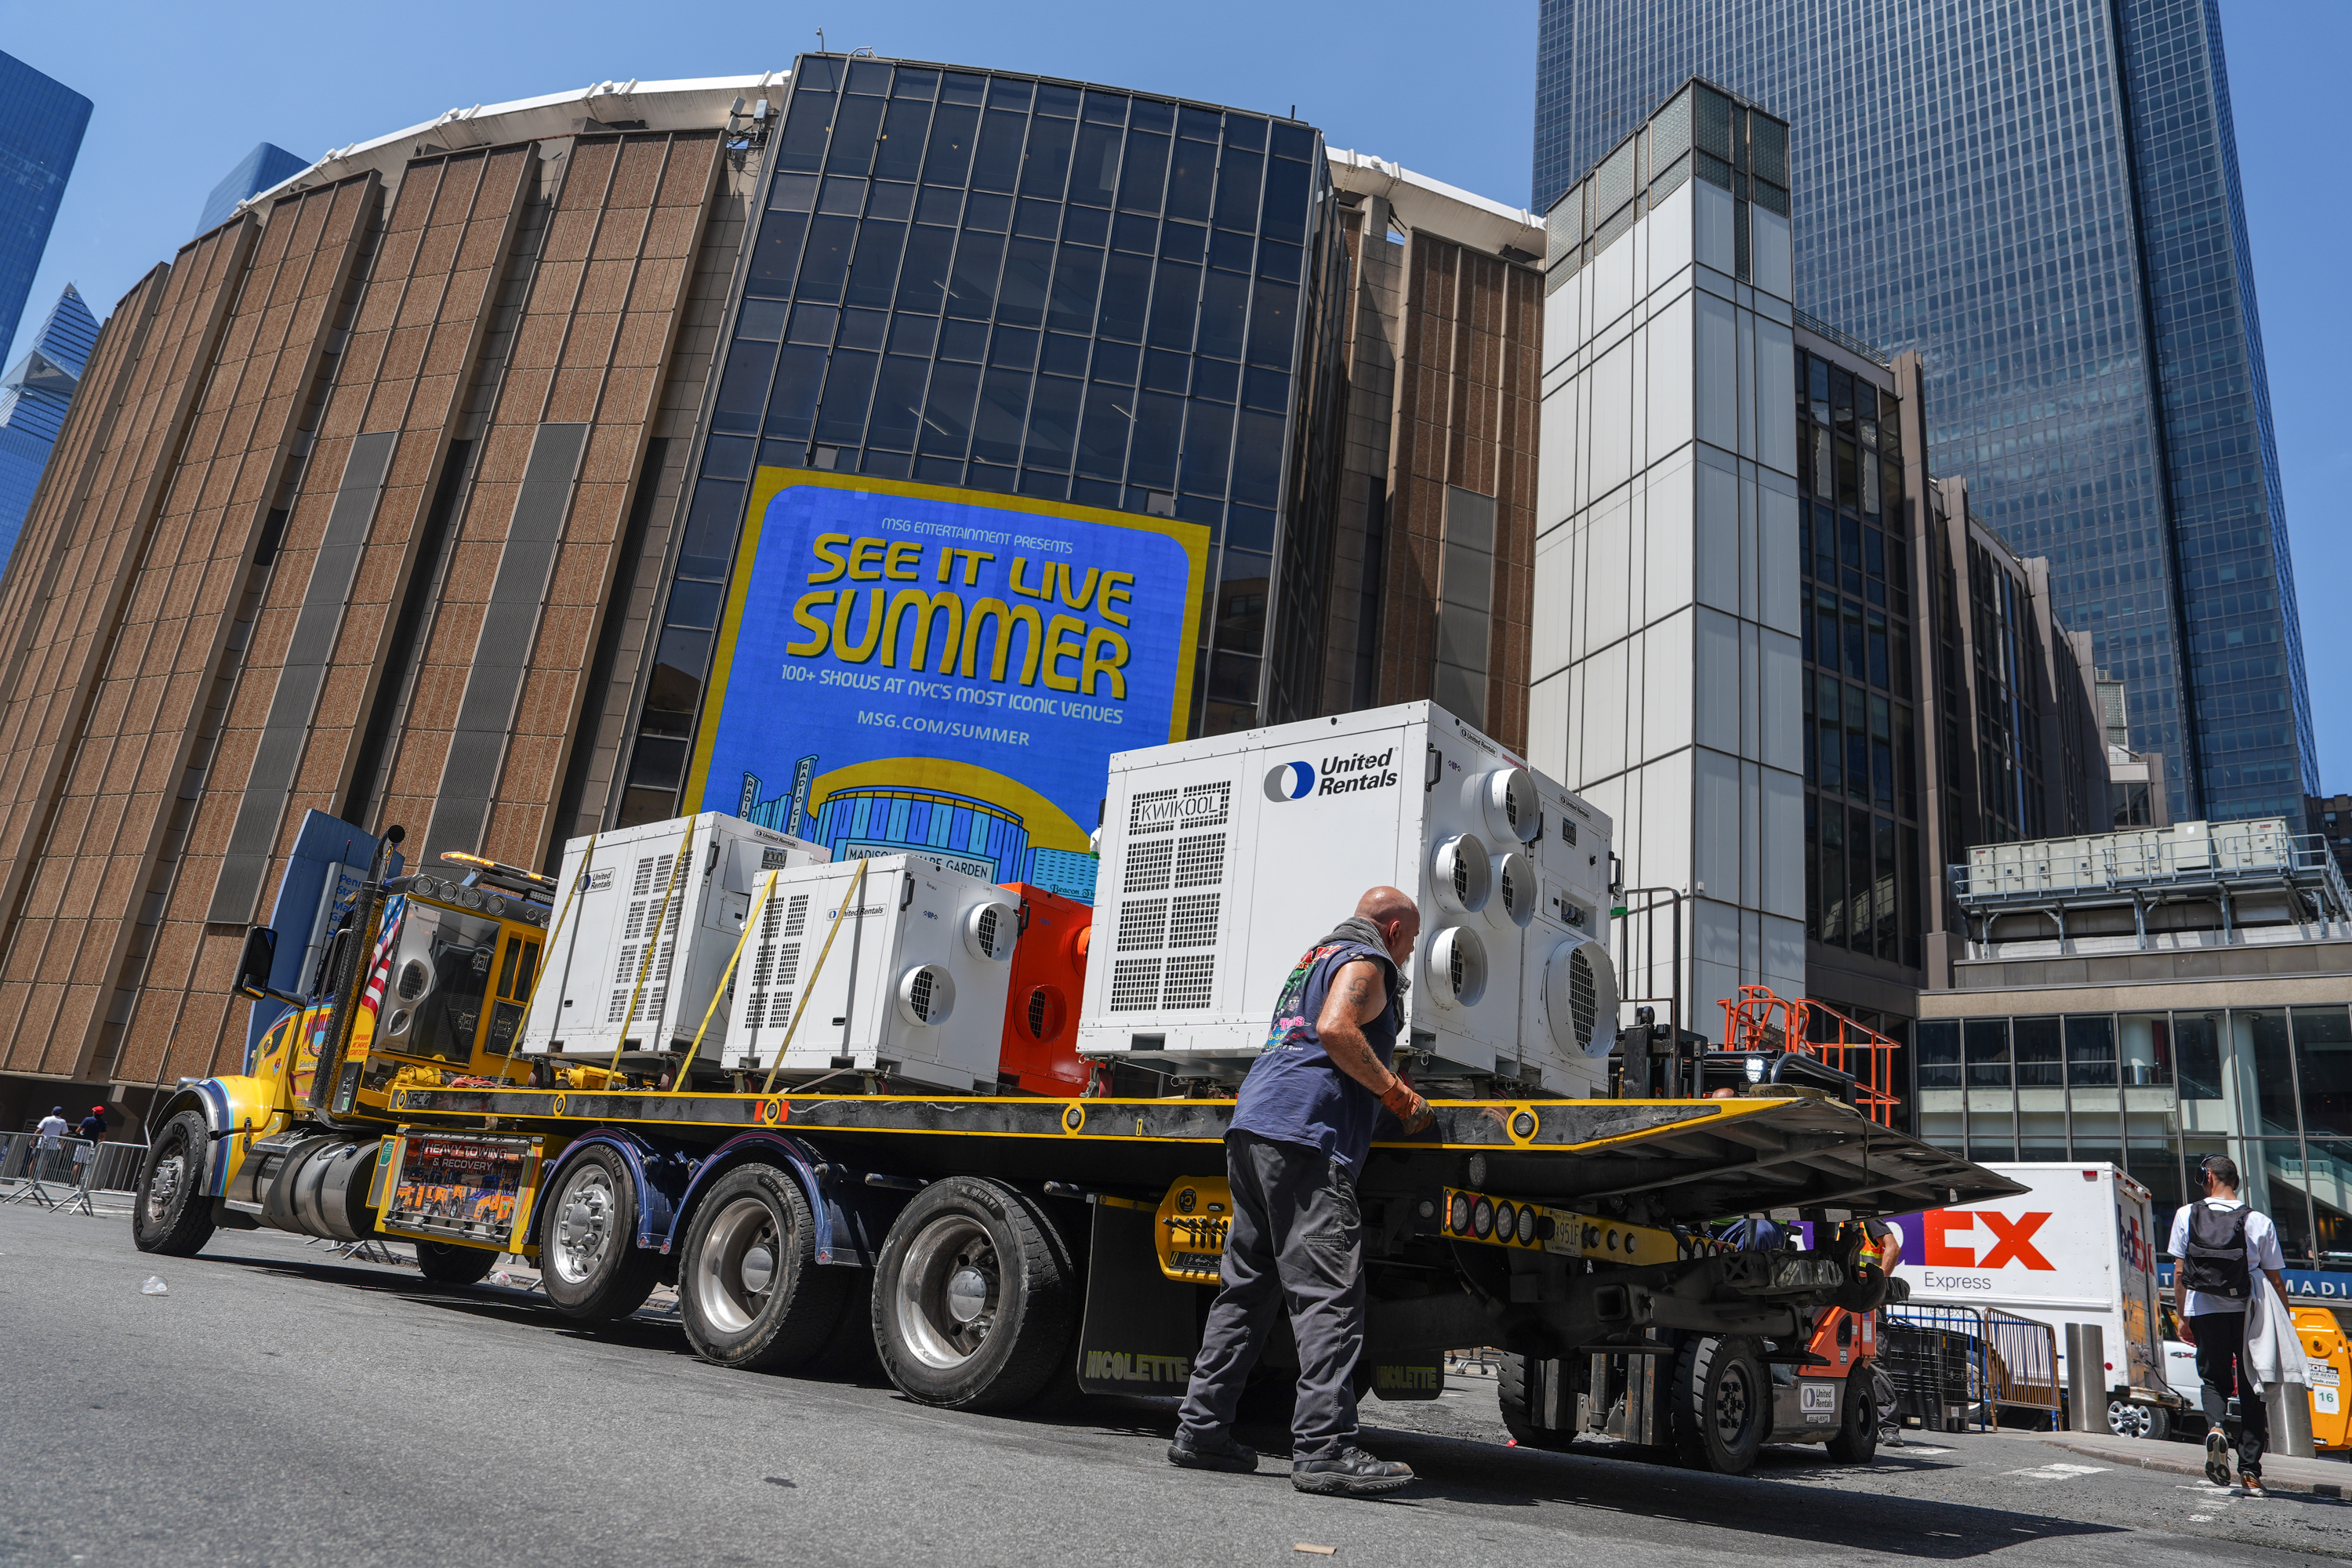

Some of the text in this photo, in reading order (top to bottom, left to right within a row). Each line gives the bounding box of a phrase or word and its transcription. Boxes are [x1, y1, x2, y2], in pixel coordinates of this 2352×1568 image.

[881, 517, 1073, 554] MSG ENTERTAINMENT PRESENTS
[806, 532, 1134, 627] SEE IT LIVE
[786, 587, 1129, 700] SUMMER
[782, 664, 1124, 724] 100+ SHOWS AT NYC'S MOST ICONIC VENUES
[857, 710, 1030, 746] MSG.COM/SUMMER
[1467, 733, 1496, 755] United Rentals
[1321, 747, 1393, 775] United
[795, 764, 808, 803] RADIO
[1318, 769, 1397, 796] Rentals
[742, 780, 753, 818] RADIO
[1142, 796, 1218, 822] KWIKOOL
[1565, 799, 1591, 819] United Rentals
[762, 833, 796, 847] United Rentals
[849, 848, 896, 860] MADIS
[946, 860, 989, 878] GARDEN
[590, 880, 612, 890] Rentals
[593, 871, 612, 880] United
[1050, 884, 1080, 895] Beacon
[843, 906, 884, 917] nited Rentals
[424, 1143, 508, 1160] HEAVY TOWING
[433, 1157, 493, 1171] & RECOVERY
[970, 1186, 1000, 1210] MULTI
[1924, 1272, 1992, 1291] Express
[1085, 1350, 1190, 1382] NICOLETTE
[1376, 1365, 1437, 1389] NICOLETTE
[1816, 1388, 1832, 1399] United
[1816, 1399, 1833, 1408] Rentals
[2318, 1392, 2334, 1403] 16
